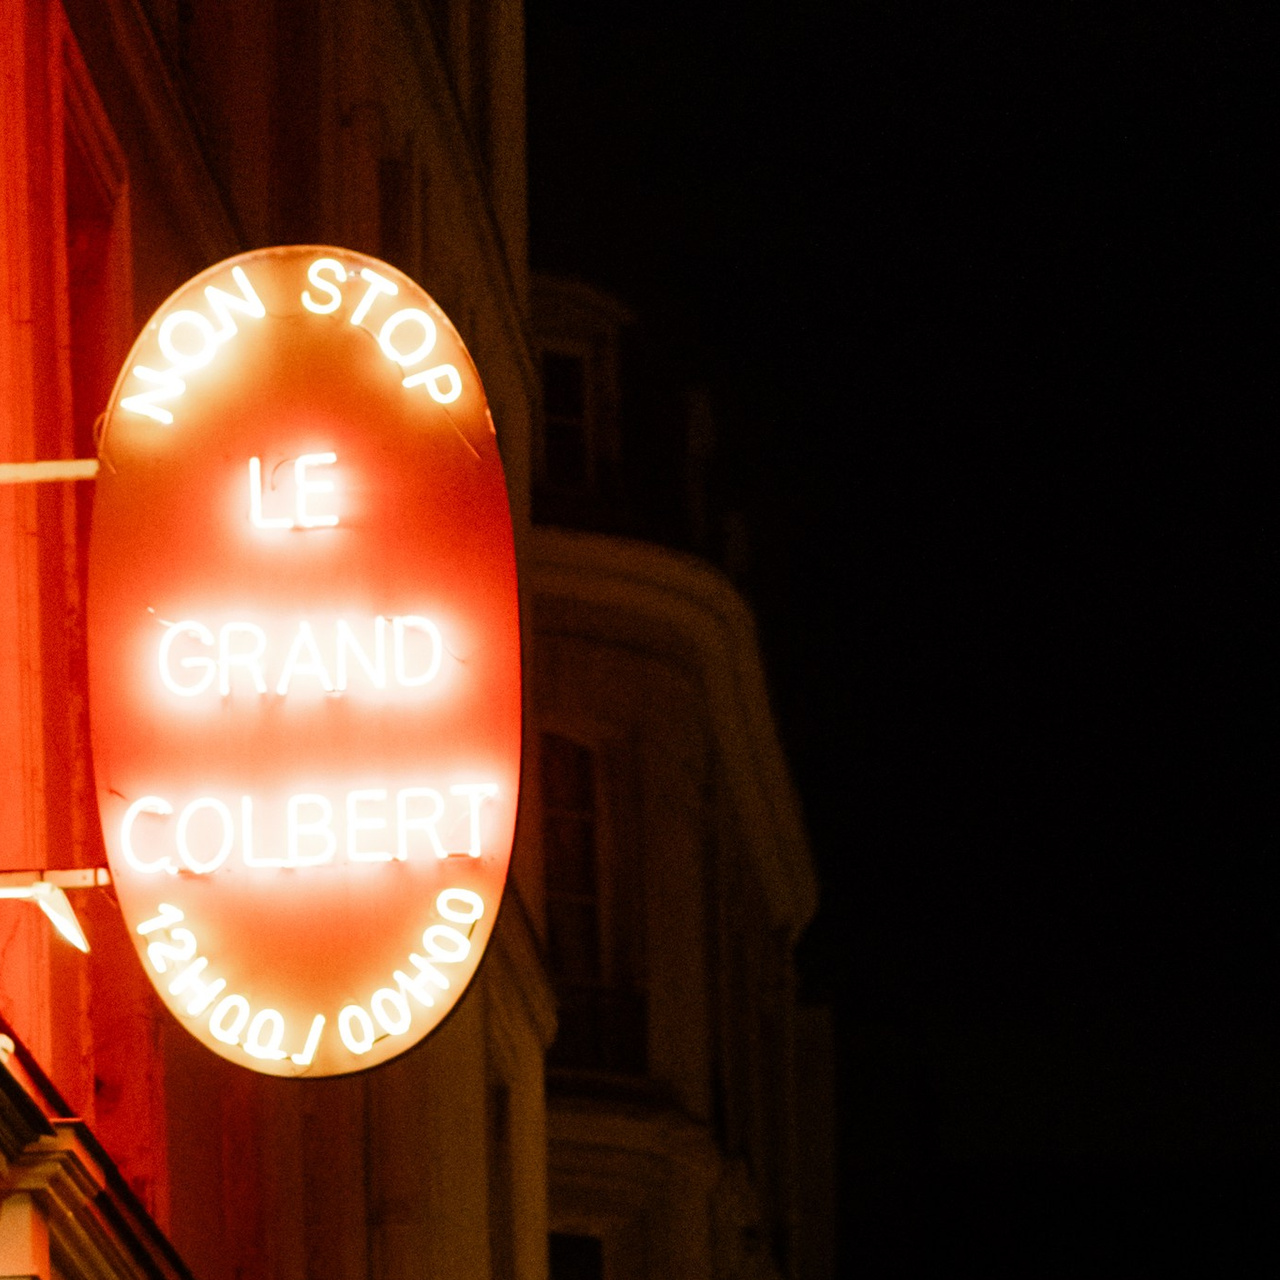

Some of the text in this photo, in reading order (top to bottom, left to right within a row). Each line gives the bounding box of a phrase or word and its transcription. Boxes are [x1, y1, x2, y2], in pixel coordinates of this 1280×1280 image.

[120, 258, 462, 425] NON STOP
[248, 452, 340, 530] LE
[157, 615, 442, 697] GRAND
[121, 782, 499, 875] COLBERT
